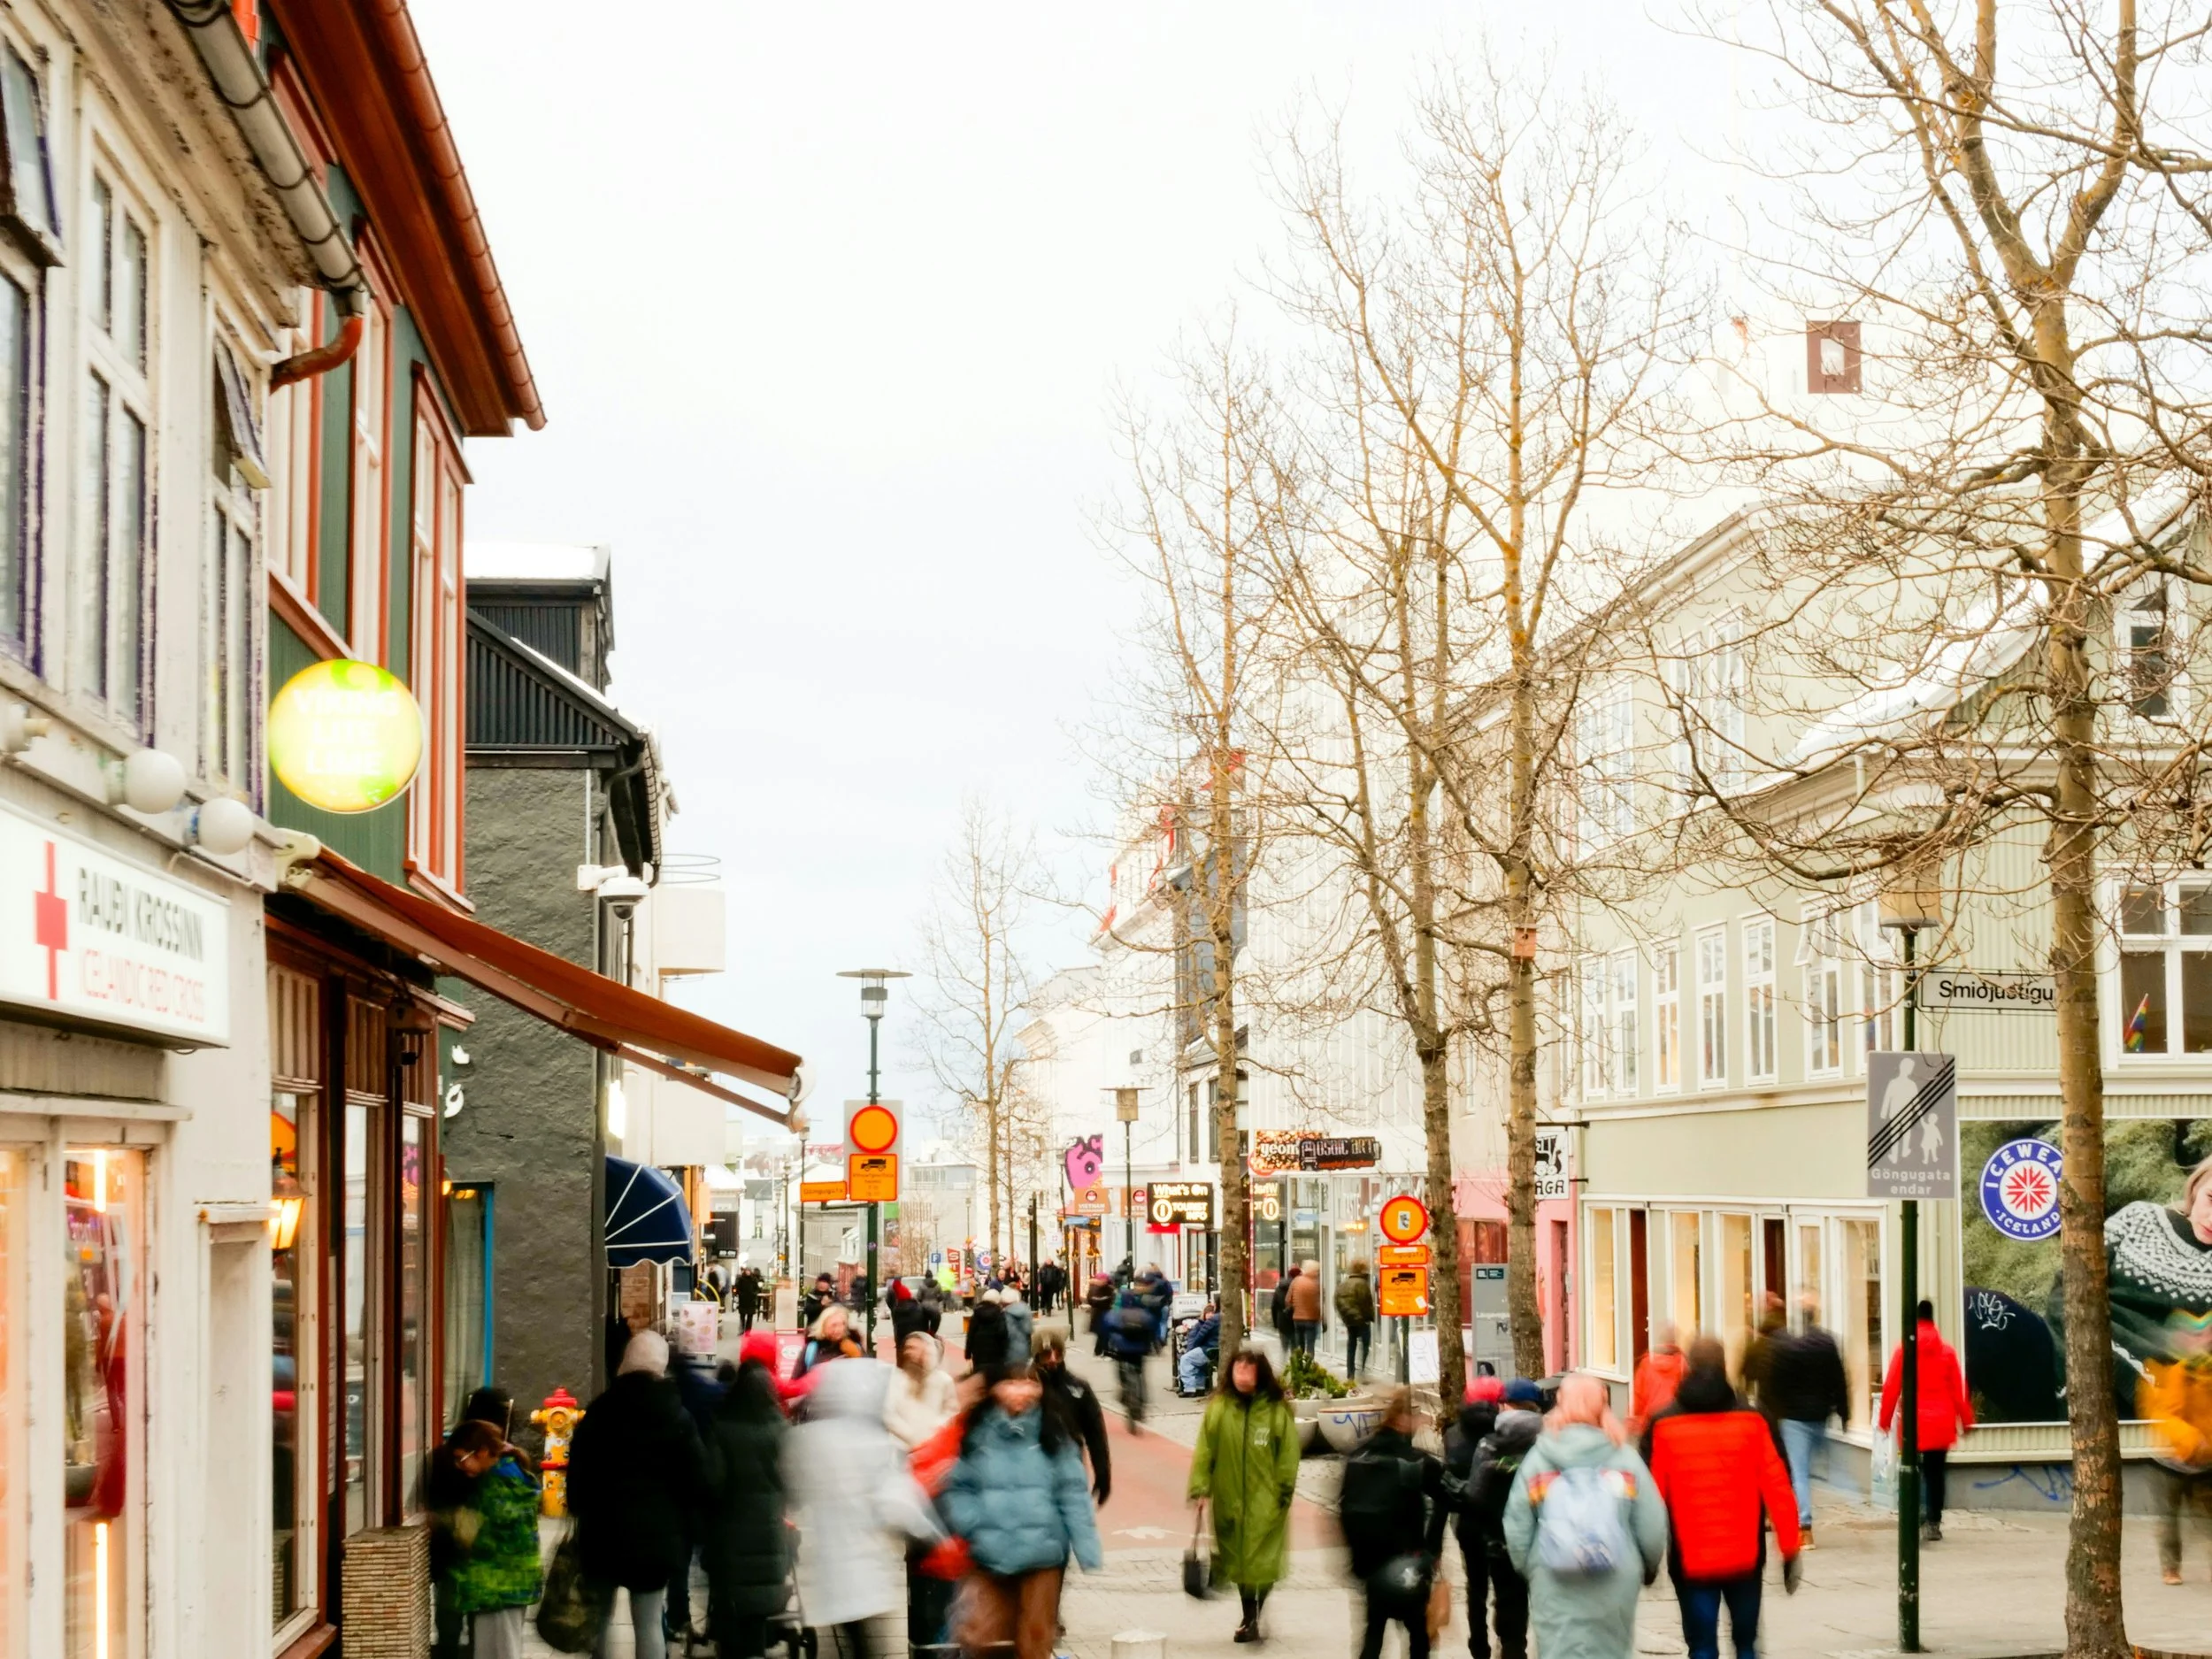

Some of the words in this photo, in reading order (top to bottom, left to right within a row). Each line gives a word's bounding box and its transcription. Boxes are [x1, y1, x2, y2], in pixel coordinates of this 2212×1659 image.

[134, 887, 204, 962] KROSSINN
[1260, 1141, 1300, 1157] yeom
[1985, 1143, 2063, 1188] ICEWEA
[1871, 1167, 1951, 1181] Göngugata
[1890, 1183, 1932, 1195] endar
